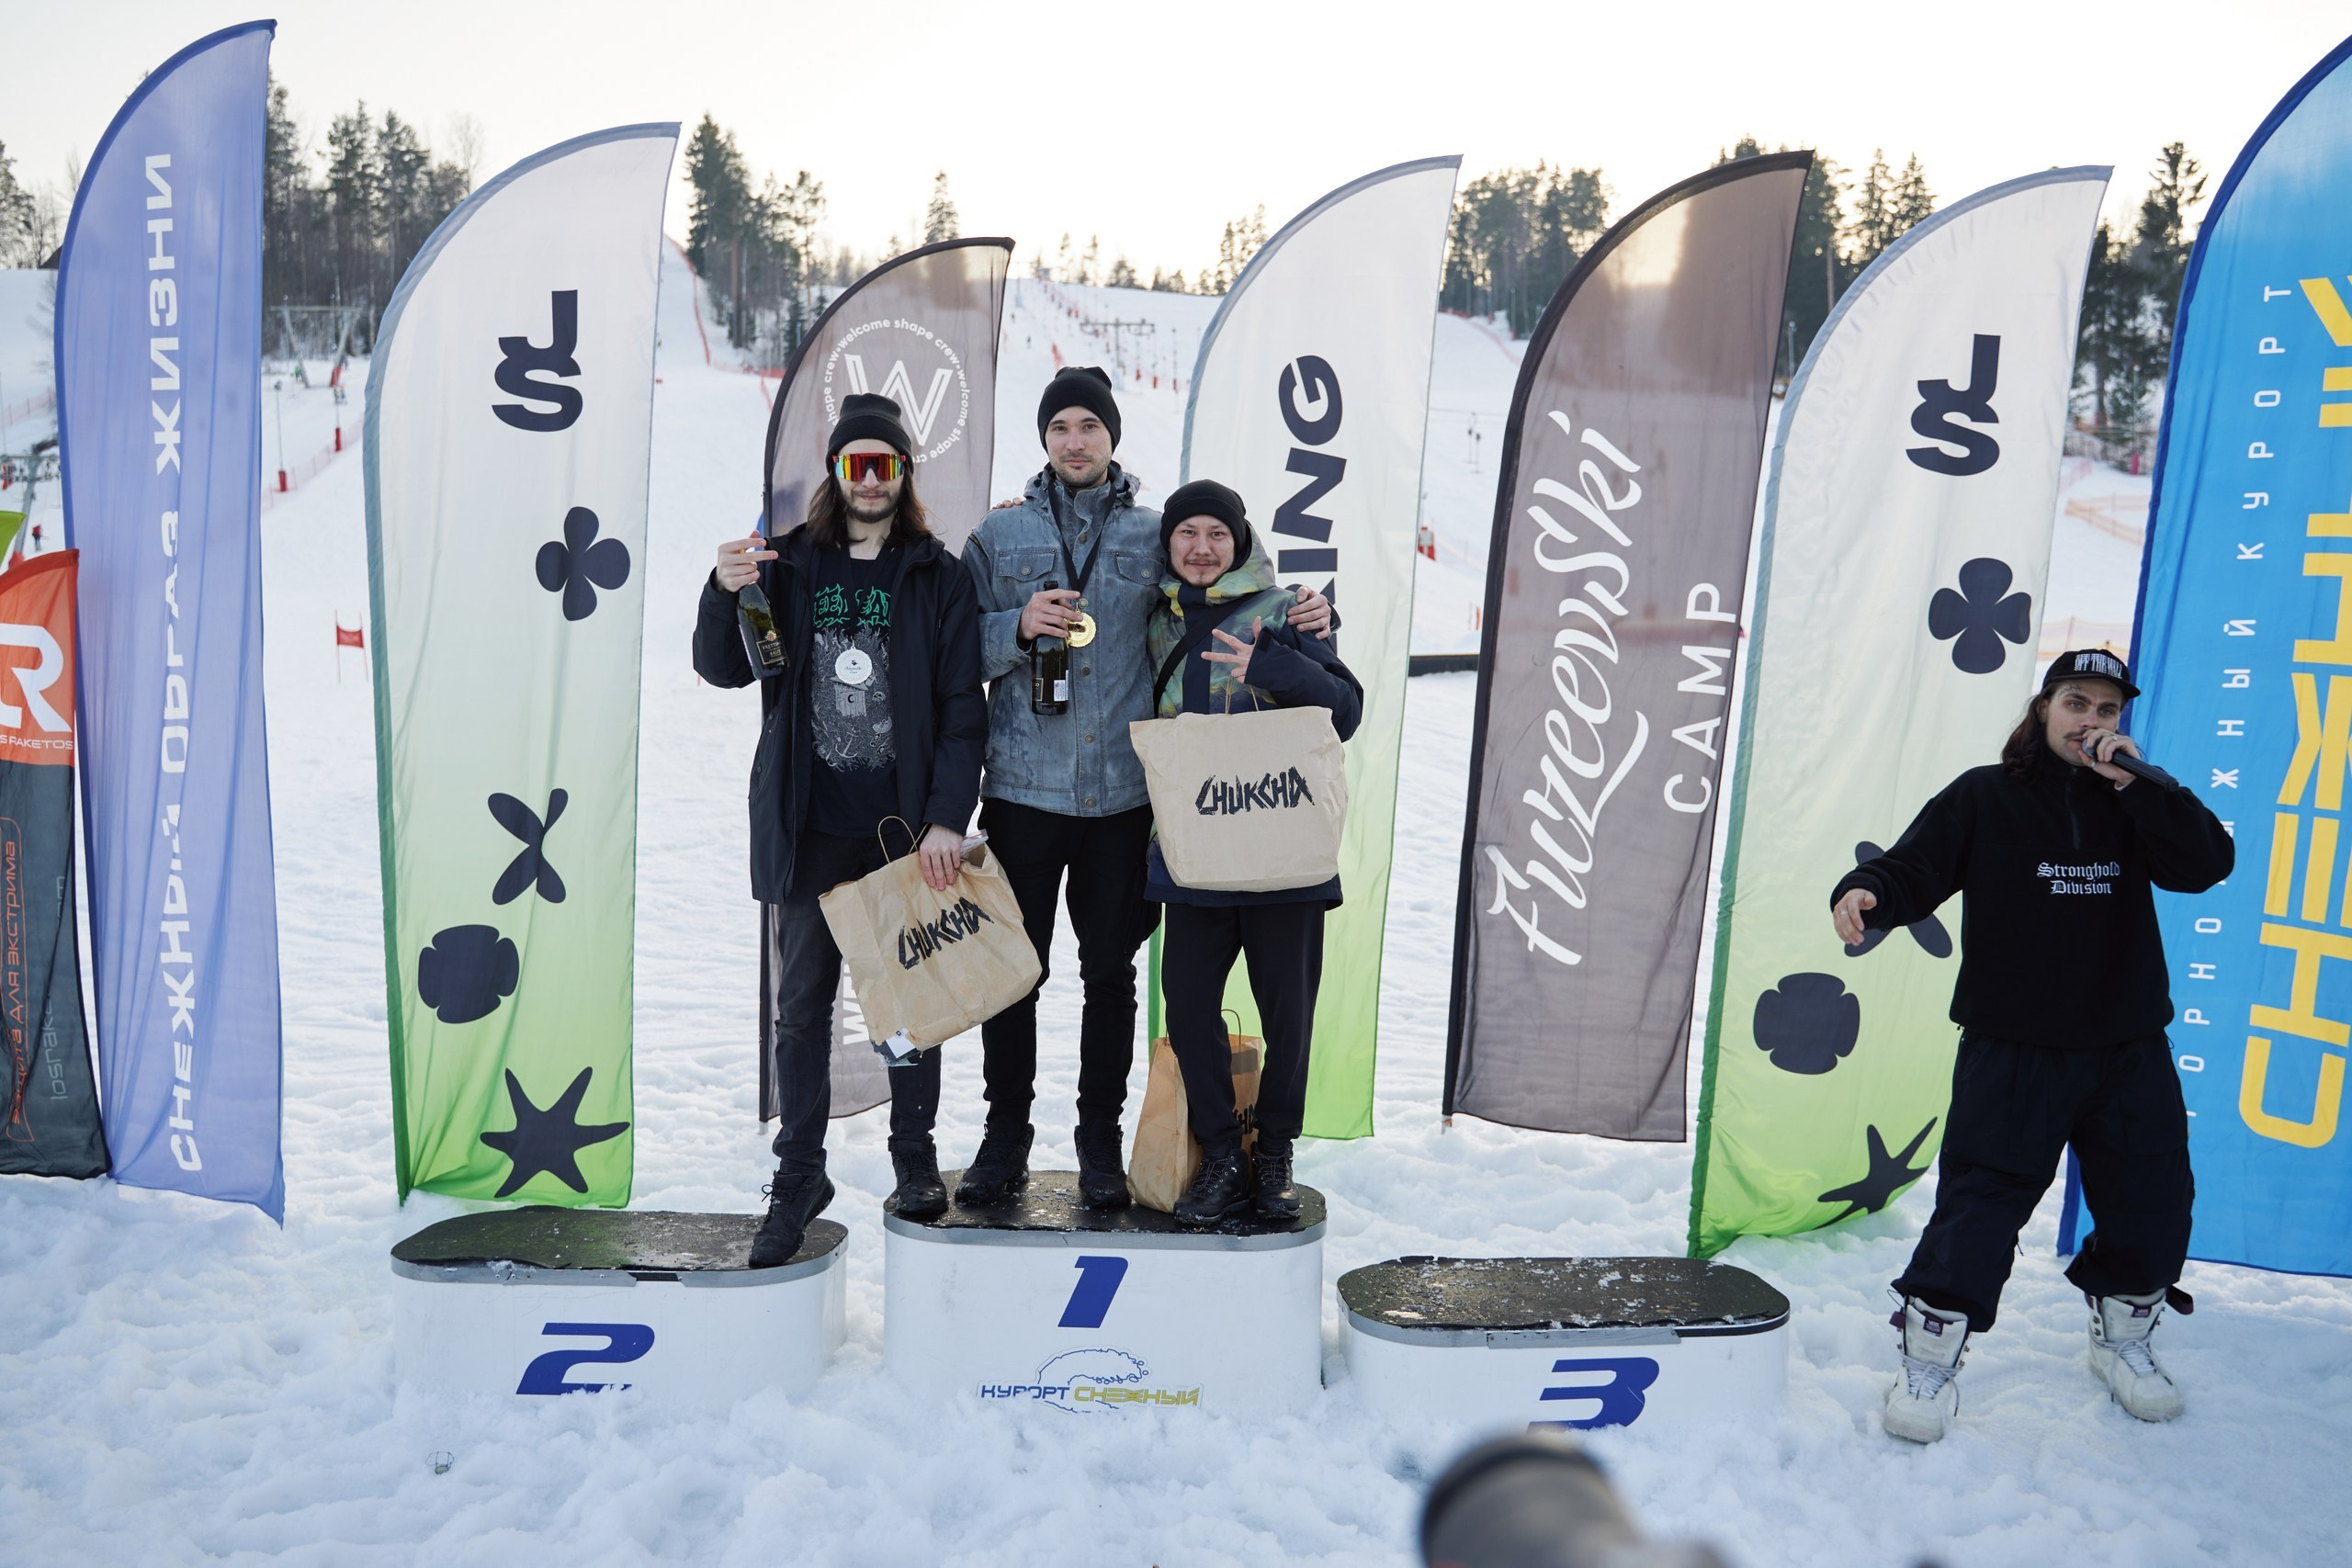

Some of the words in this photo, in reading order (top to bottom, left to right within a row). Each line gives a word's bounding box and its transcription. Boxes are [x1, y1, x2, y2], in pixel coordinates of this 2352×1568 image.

[145, 154, 180, 475] ЖИЗНИ
[894, 319, 933, 340] shape
[837, 319, 890, 349] welcome
[824, 351, 840, 383] crew
[934, 338, 960, 365] crew
[957, 369, 971, 426] welcome
[929, 427, 961, 458] shape
[2074, 653, 2090, 671] OFF
[2091, 653, 2107, 673] THE
[2107, 657, 2122, 679] WALL
[1664, 582, 1736, 814] CAMP
[2177, 619, 2256, 1117] ОРНОЖНЫЙ
[2236, 286, 2291, 559] КУРОРТ
[9, 736, 74, 750] RAKETOS
[1194, 766, 1316, 816] CHUKCHA
[2037, 862, 2120, 880] Stronghold
[2050, 879, 2112, 894] Division
[898, 897, 994, 970] CHUKCHA
[1057, 1256, 1129, 1328] 1
[515, 1323, 655, 1395] 2
[1074, 1386, 1200, 1405] СНЕЖНЫЙ
[1527, 1357, 1660, 1431] 3
